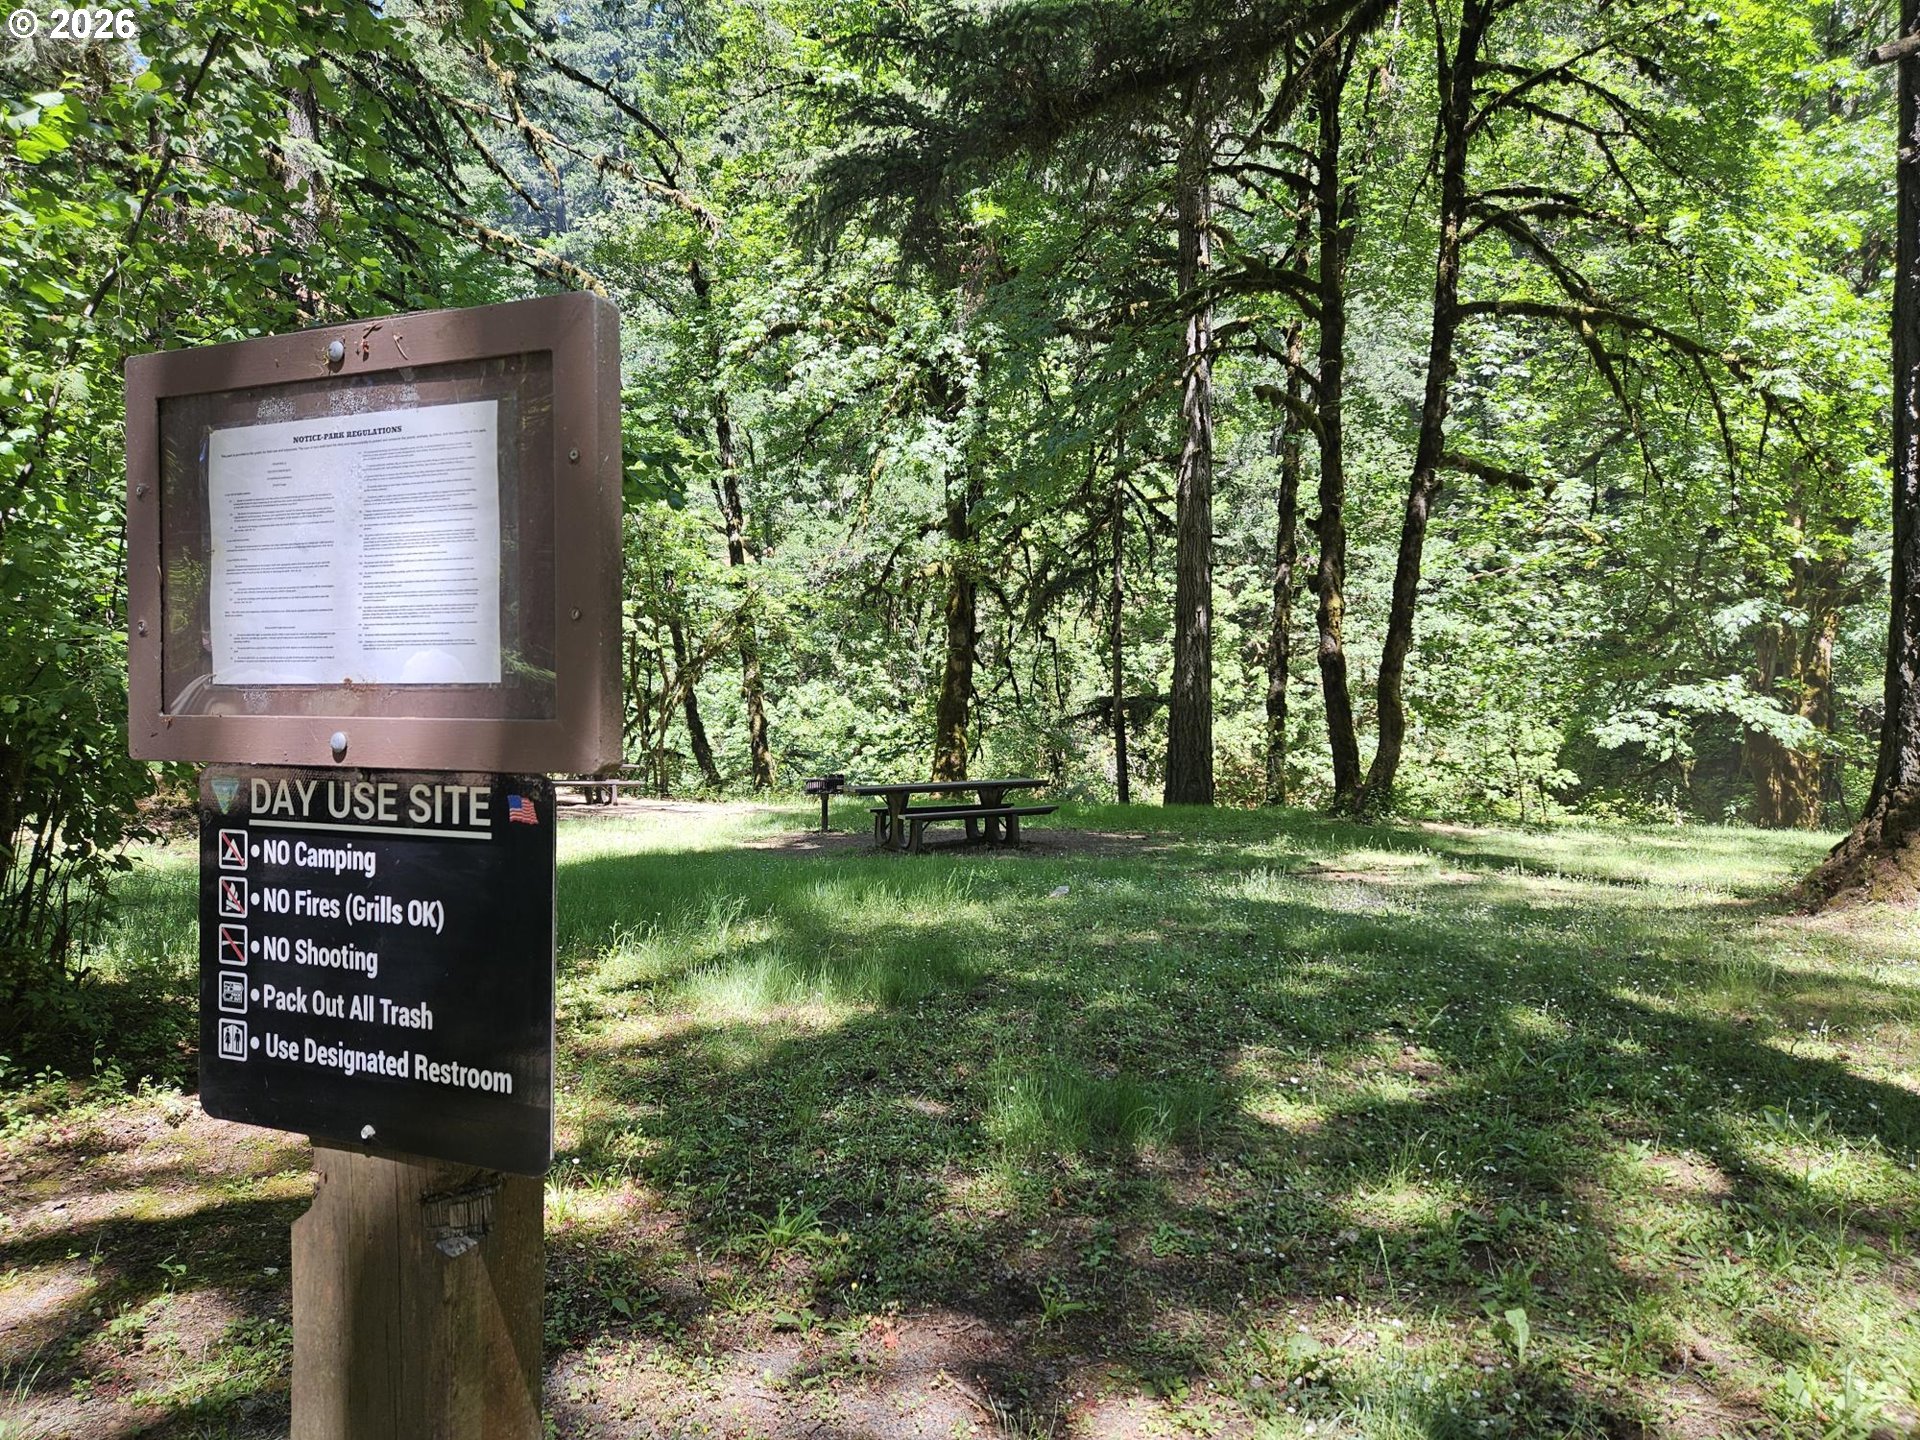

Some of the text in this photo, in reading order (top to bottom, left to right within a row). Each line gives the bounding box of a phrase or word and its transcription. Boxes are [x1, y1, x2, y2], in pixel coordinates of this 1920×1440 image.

[346, 425, 403, 438] REGULATIONS
[251, 778, 492, 826] DAY USE SITE
[263, 839, 377, 879] NO Camping
[263, 888, 445, 935] NO Fires (Grills OK)
[263, 936, 378, 979] NO Shooting
[263, 984, 308, 1014] Pack
[312, 989, 345, 1019] Out
[349, 994, 375, 1024] All
[379, 998, 434, 1030] Trash
[265, 1032, 513, 1094] Use Designated Restroom
